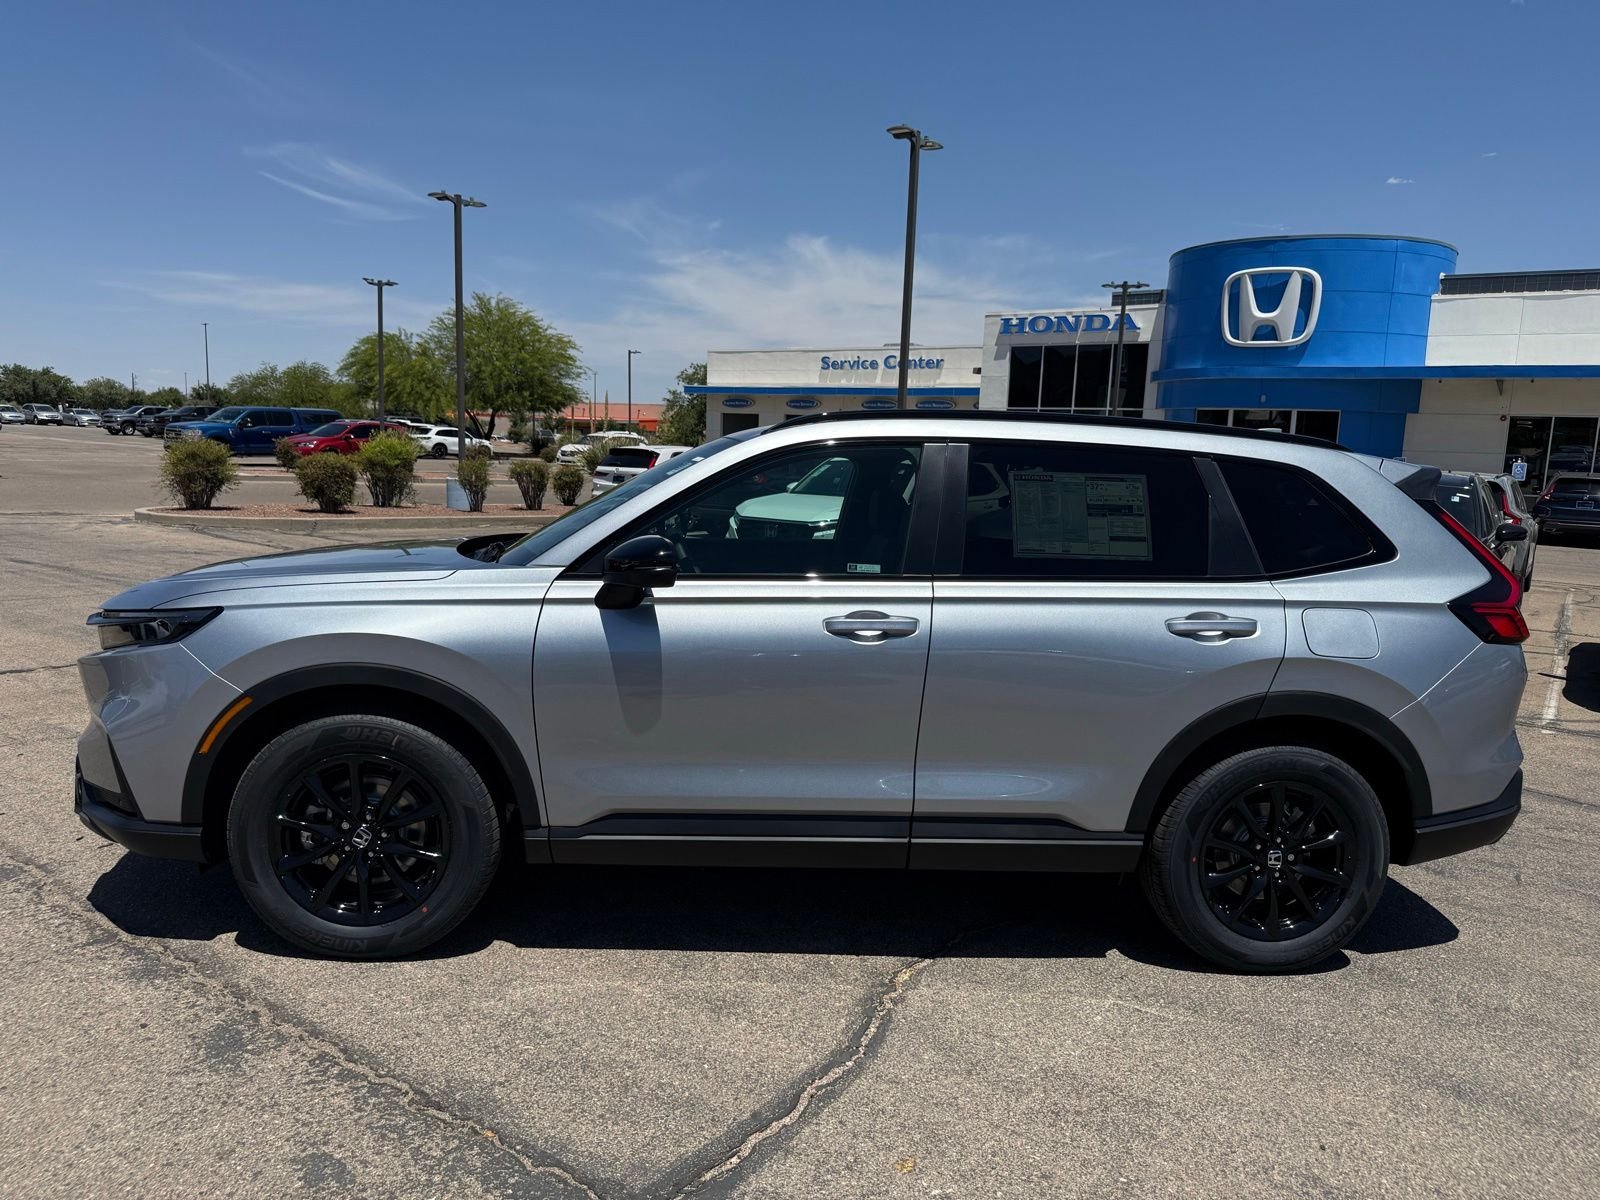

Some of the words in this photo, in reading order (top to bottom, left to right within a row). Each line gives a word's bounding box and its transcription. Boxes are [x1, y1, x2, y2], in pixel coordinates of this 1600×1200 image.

[1000, 313, 1140, 334] HONDA
[821, 356, 879, 371] Service
[884, 354, 944, 371] Cnter
